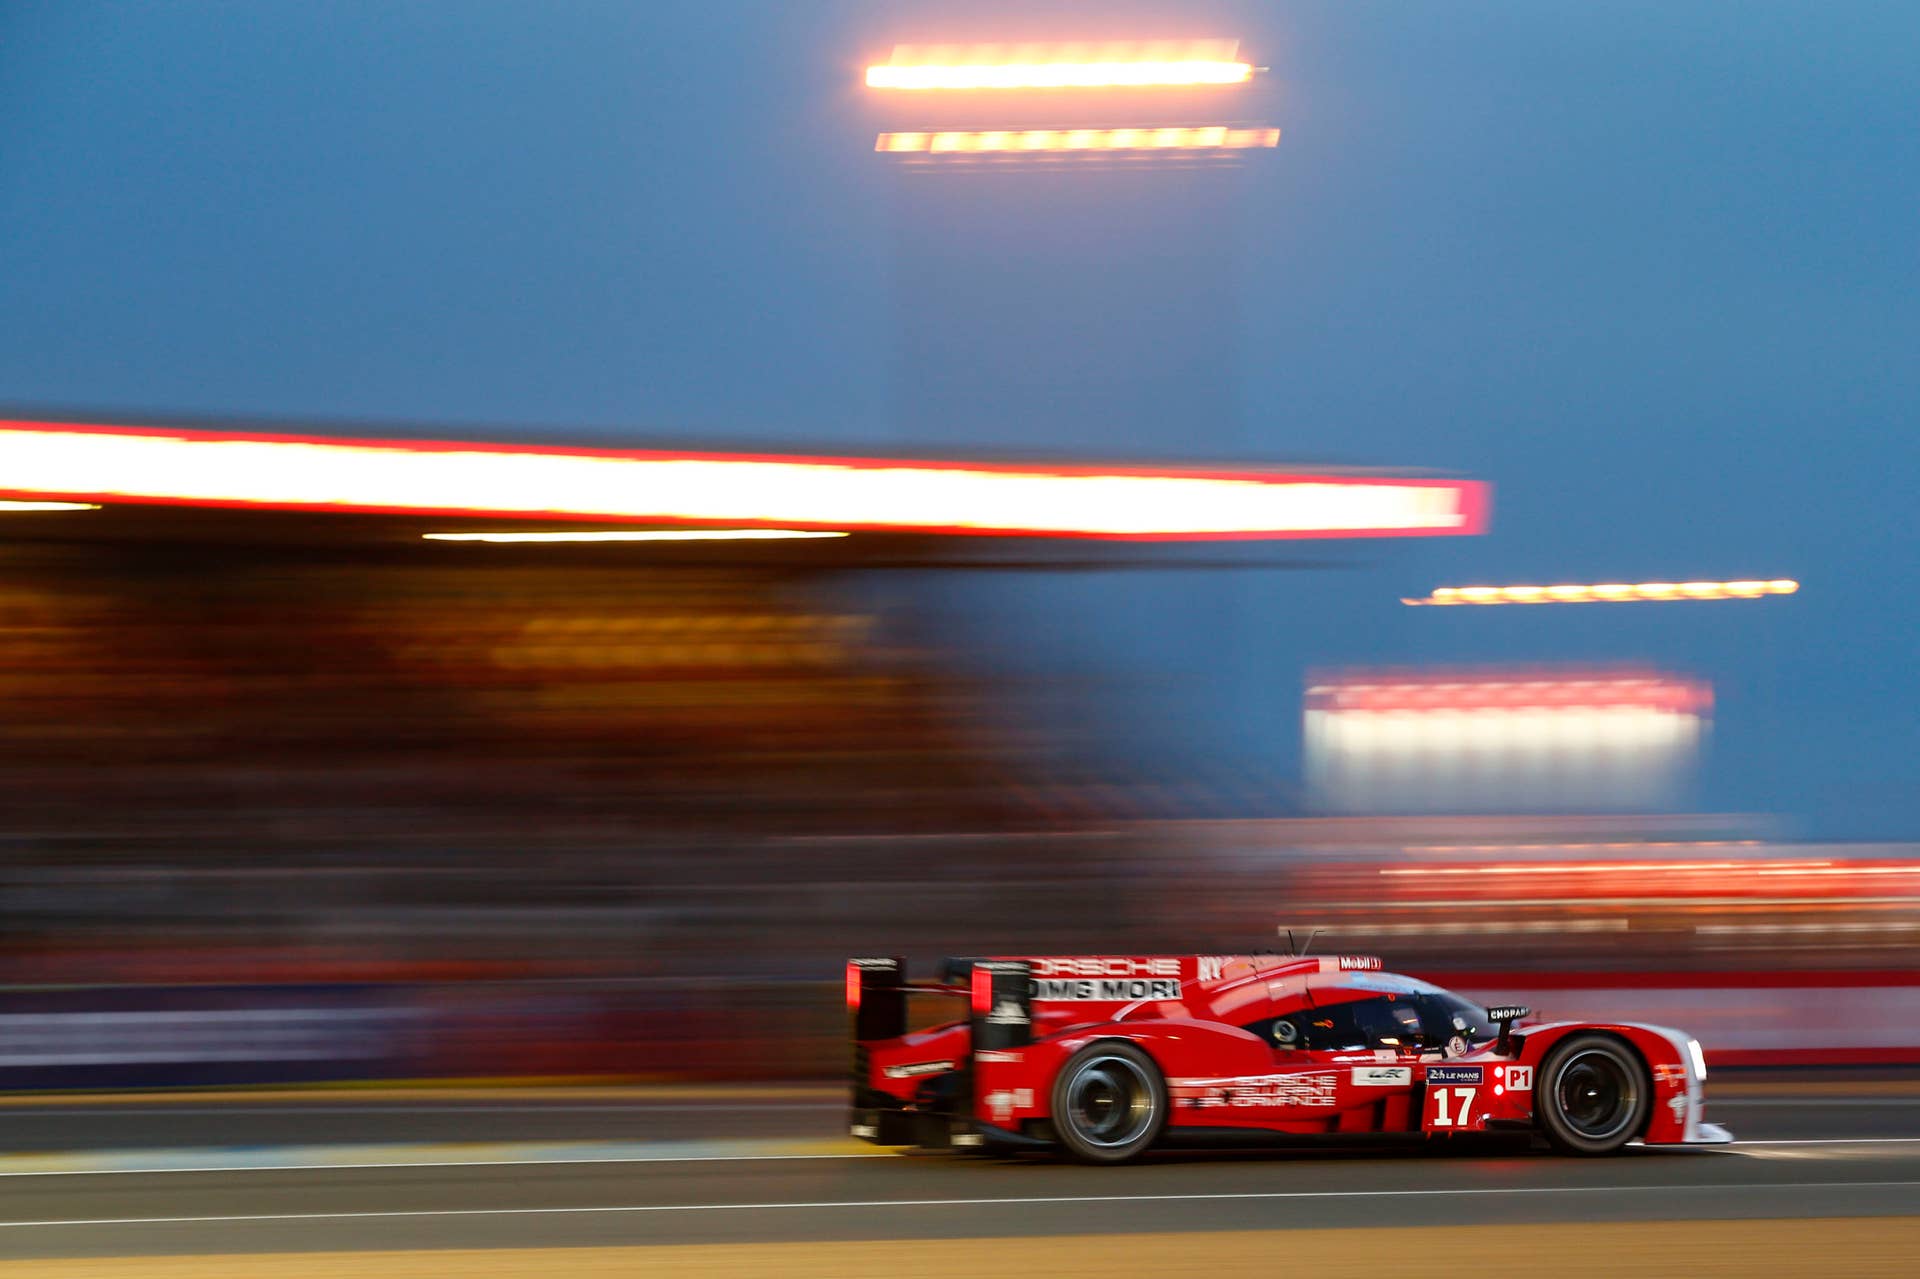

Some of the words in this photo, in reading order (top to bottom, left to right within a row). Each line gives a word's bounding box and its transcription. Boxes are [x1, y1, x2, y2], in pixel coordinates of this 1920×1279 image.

[1029, 958, 1182, 976] ORSCHE
[1340, 956, 1370, 969] Mobil
[1509, 1069, 1529, 1088] P1
[1433, 1087, 1477, 1127] 17
